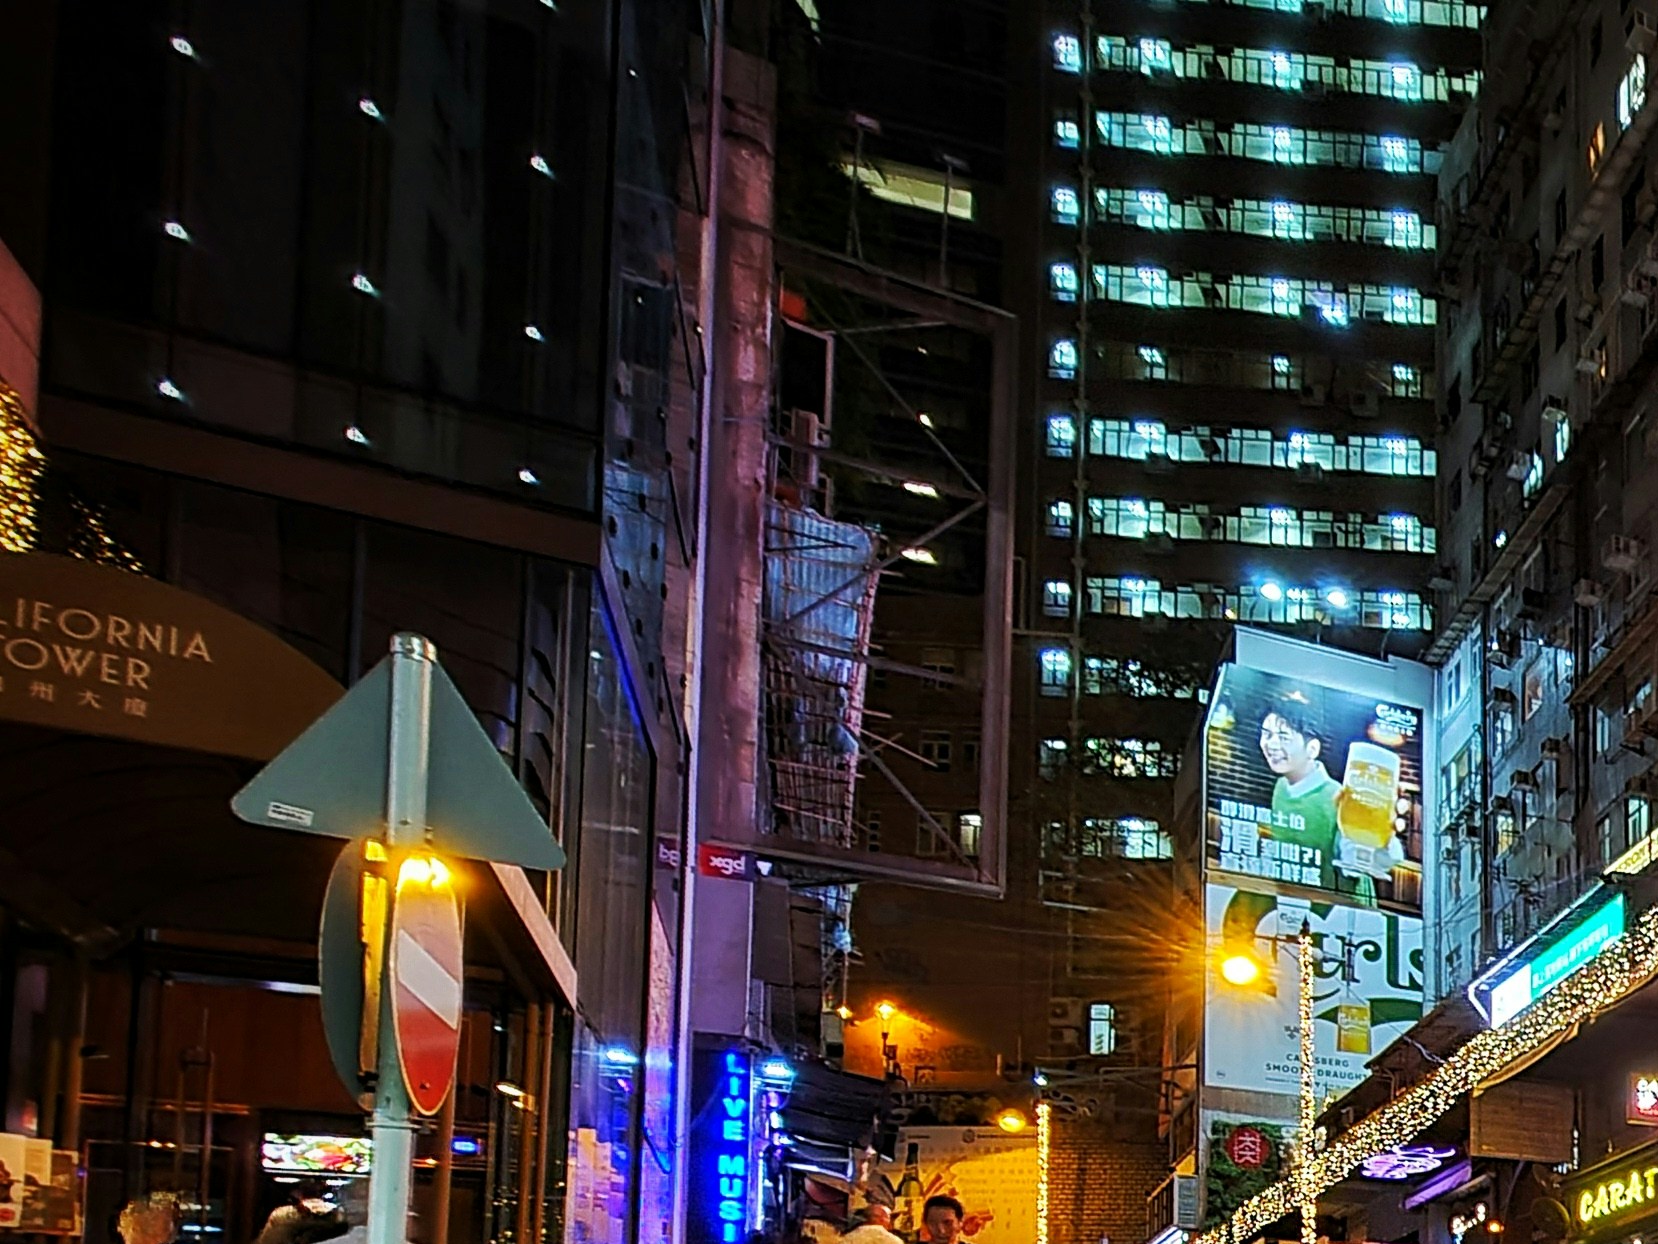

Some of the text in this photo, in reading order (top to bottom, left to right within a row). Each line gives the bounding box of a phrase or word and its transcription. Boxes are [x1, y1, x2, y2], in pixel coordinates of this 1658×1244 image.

[0, 598, 213, 663] IFORNIA
[0, 633, 150, 690] OWER
[724, 1053, 747, 1141] LIVE
